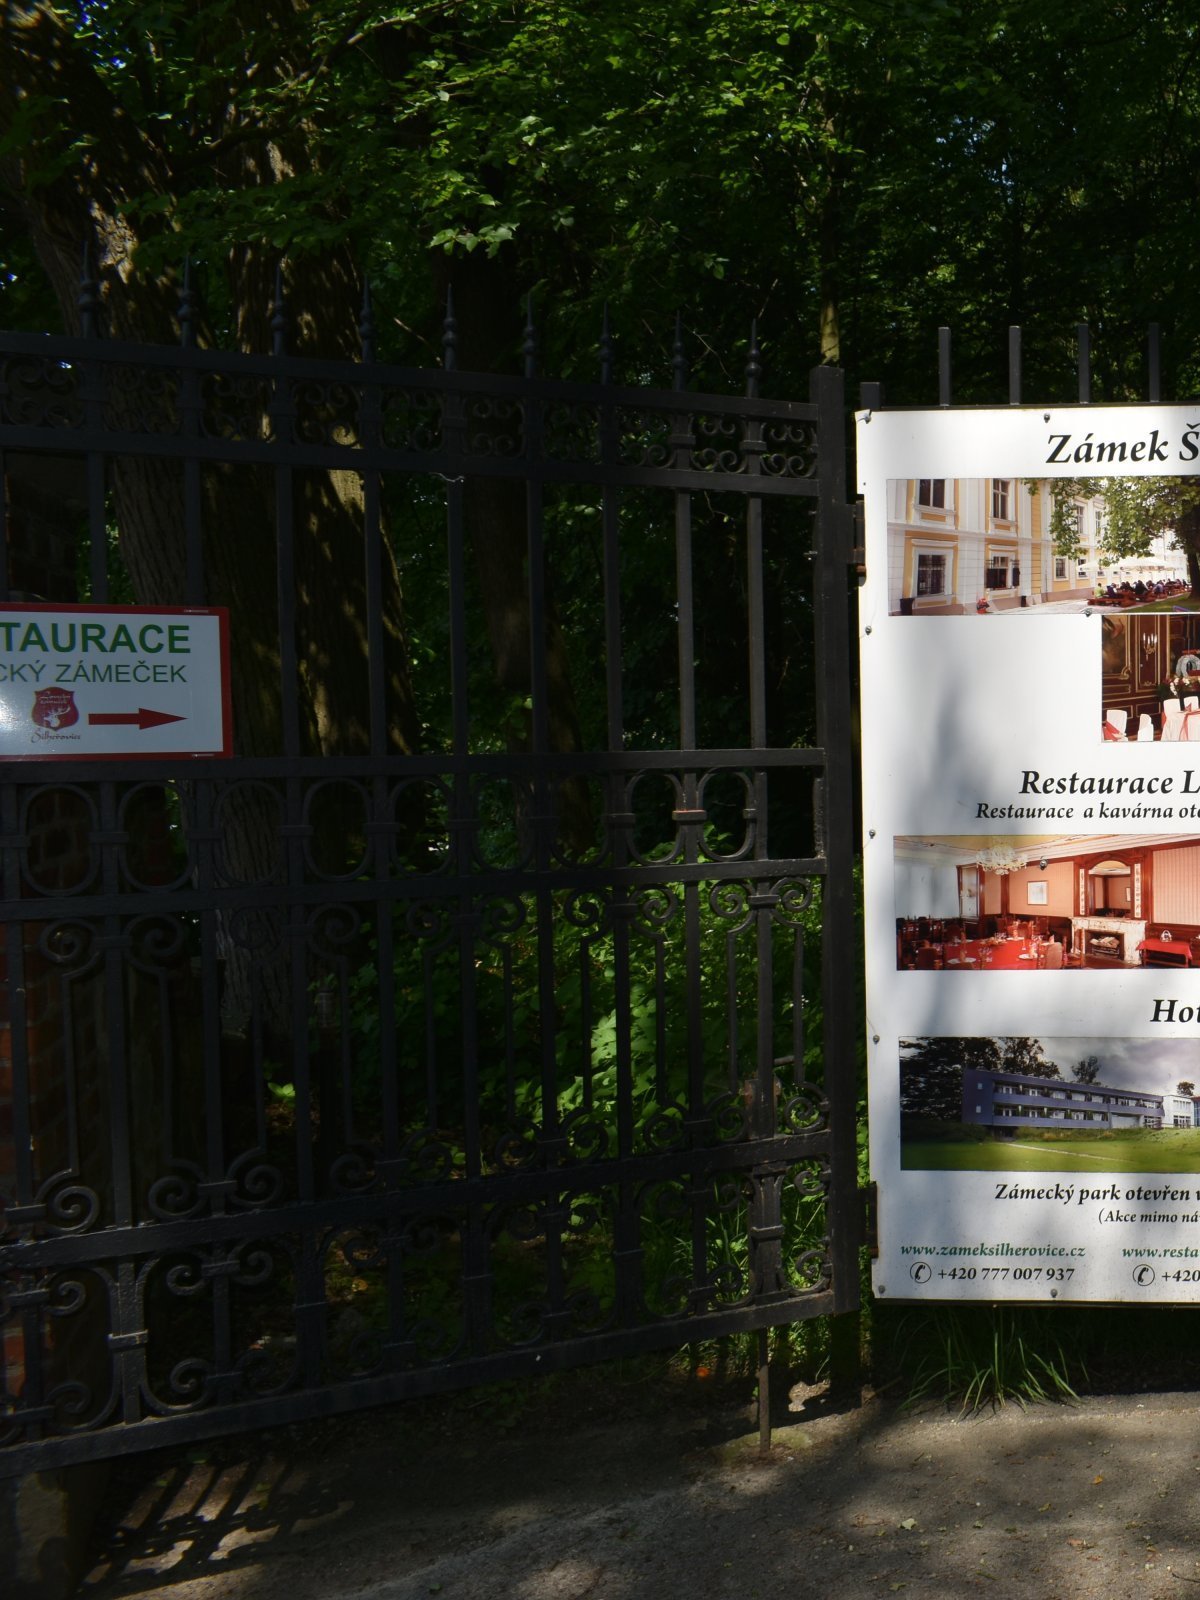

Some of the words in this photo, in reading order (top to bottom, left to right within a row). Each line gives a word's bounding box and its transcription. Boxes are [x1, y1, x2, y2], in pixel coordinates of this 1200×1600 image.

[1045, 431, 1169, 464] Zámek
[0, 622, 191, 654] TAURACE
[55, 660, 187, 683] ZÁMEČEK
[1018, 770, 1174, 795] Restaurace
[975, 802, 1074, 819] Restaurace
[1083, 806, 1094, 819] a
[1099, 802, 1174, 819] kavárna
[994, 1183, 1075, 1205] Zámecký
[1078, 1184, 1121, 1205] park
[1125, 1184, 1191, 1201] otevřen
[1098, 1208, 1137, 1224] (Akce
[1140, 1210, 1178, 1223] mimo
[900, 1243, 1086, 1257] www.zameksilherovice.cz
[937, 1267, 977, 1281] +420
[981, 1268, 1010, 1281] 777
[1013, 1268, 1043, 1281] 007
[1046, 1268, 1075, 1281] 937
